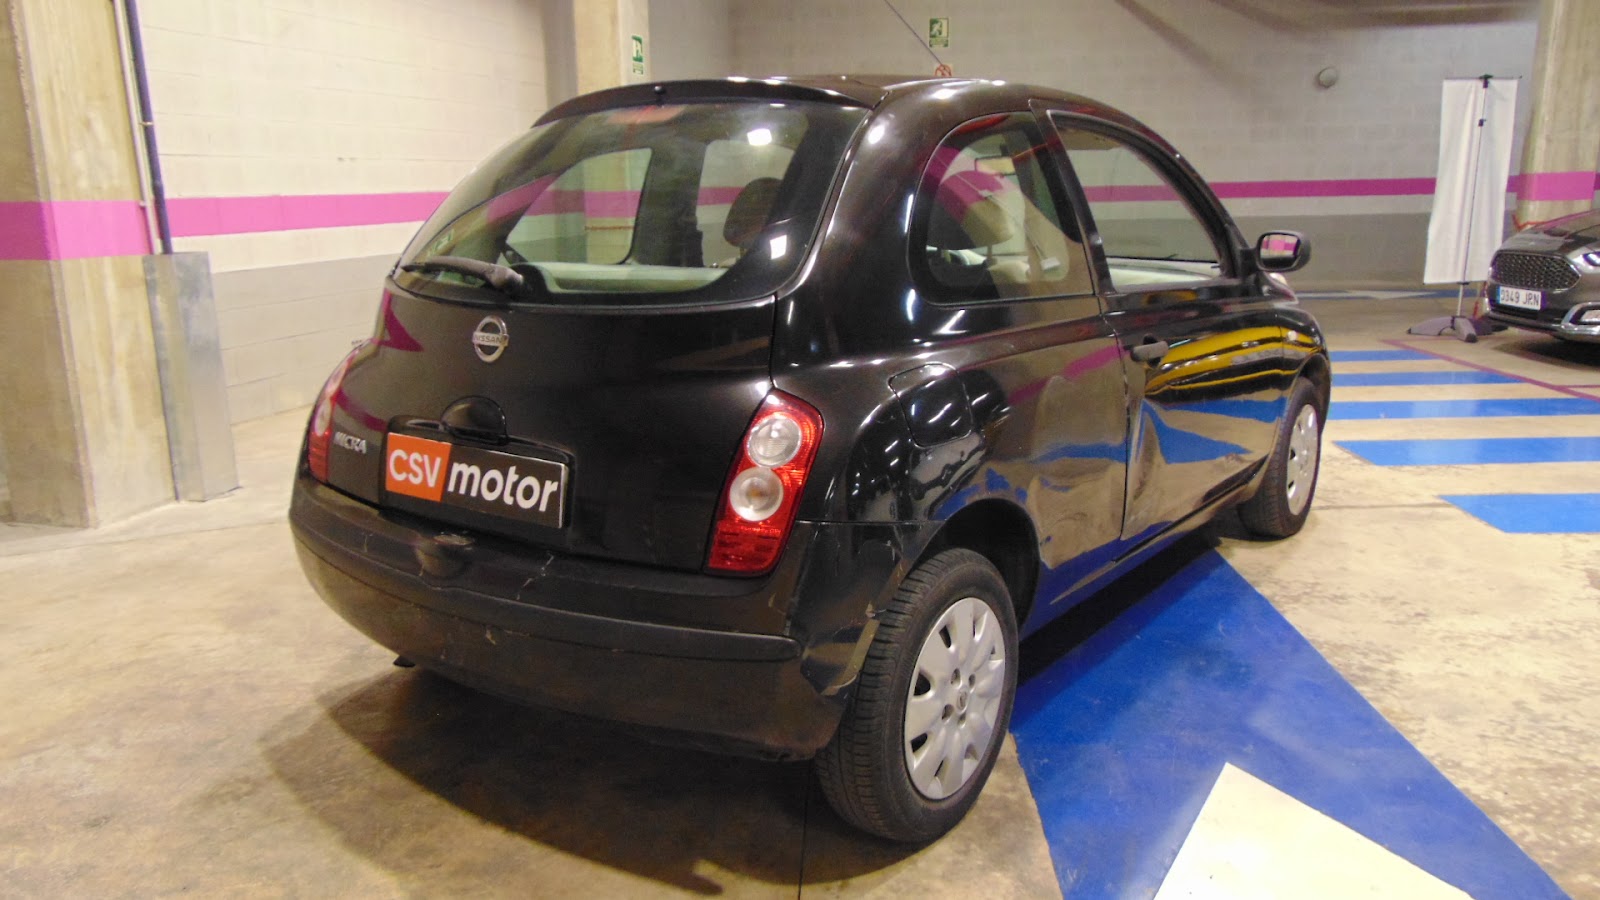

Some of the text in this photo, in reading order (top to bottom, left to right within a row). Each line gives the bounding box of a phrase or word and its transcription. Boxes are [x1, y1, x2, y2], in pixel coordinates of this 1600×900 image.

[473, 333, 503, 344] NISSAN
[333, 431, 367, 454] MICRA
[389, 449, 559, 512] CSV motor
